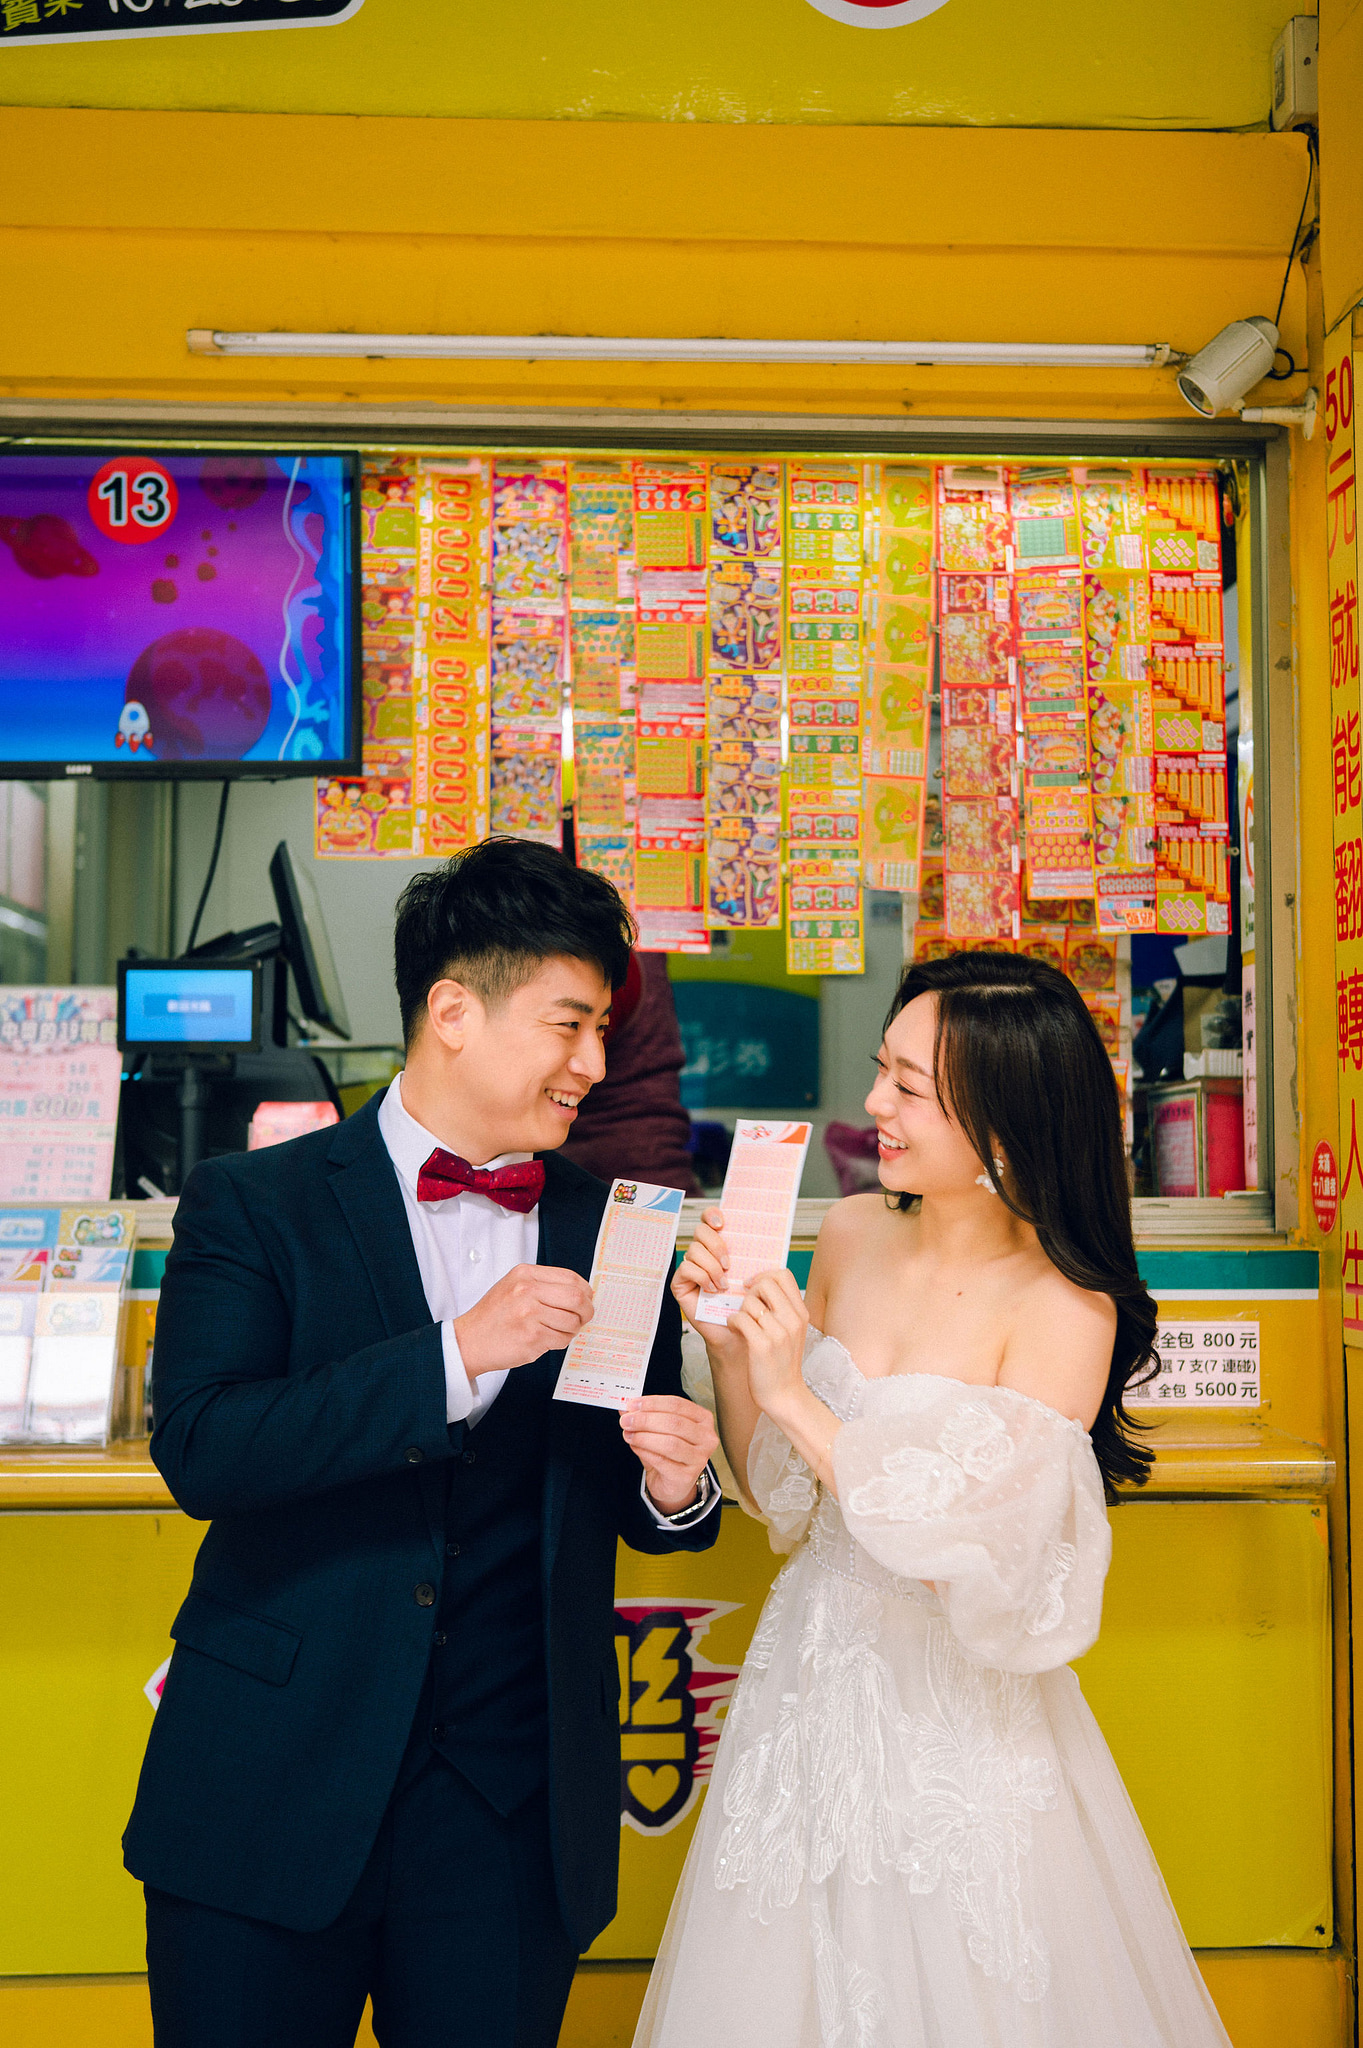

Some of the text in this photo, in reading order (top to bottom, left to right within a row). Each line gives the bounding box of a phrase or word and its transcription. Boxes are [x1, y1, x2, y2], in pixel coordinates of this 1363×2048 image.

[98, 471, 171, 527] 13
[1203, 1332, 1235, 1347] 800
[1240, 1332, 1257, 1349] 元
[1158, 1383, 1187, 1399] 全包
[1194, 1382, 1237, 1397] 5600
[1240, 1381, 1258, 1399] 元
